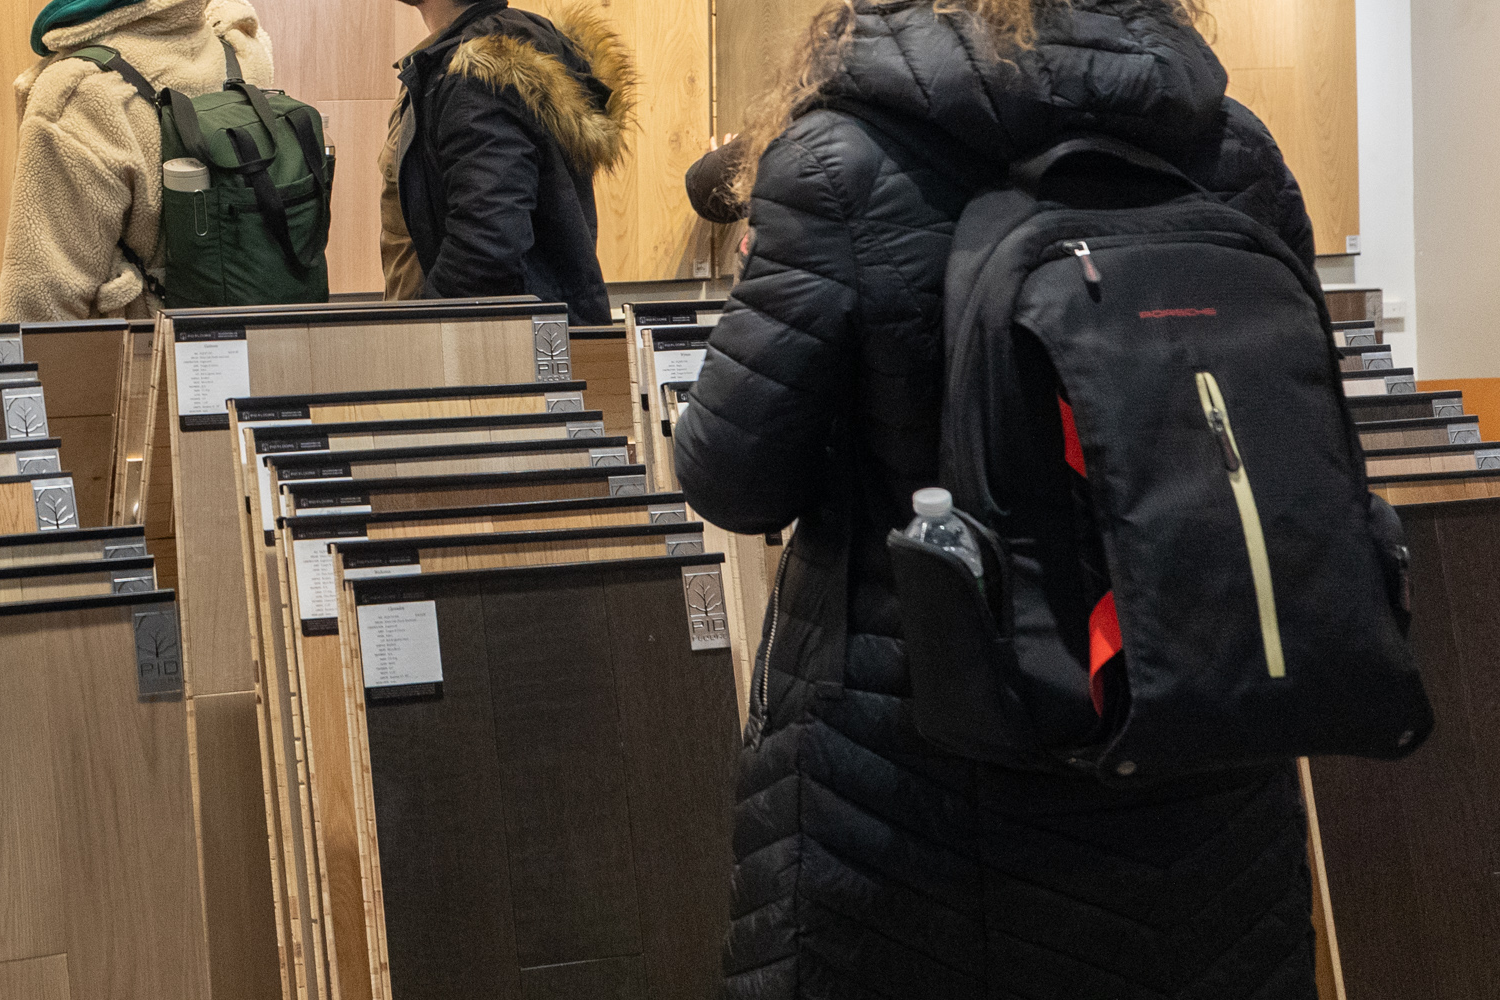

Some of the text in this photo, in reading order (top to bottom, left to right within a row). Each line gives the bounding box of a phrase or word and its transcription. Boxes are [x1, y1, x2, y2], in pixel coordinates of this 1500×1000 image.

[538, 362, 569, 374] PID
[692, 618, 726, 633] PID
[141, 661, 178, 677] PID
